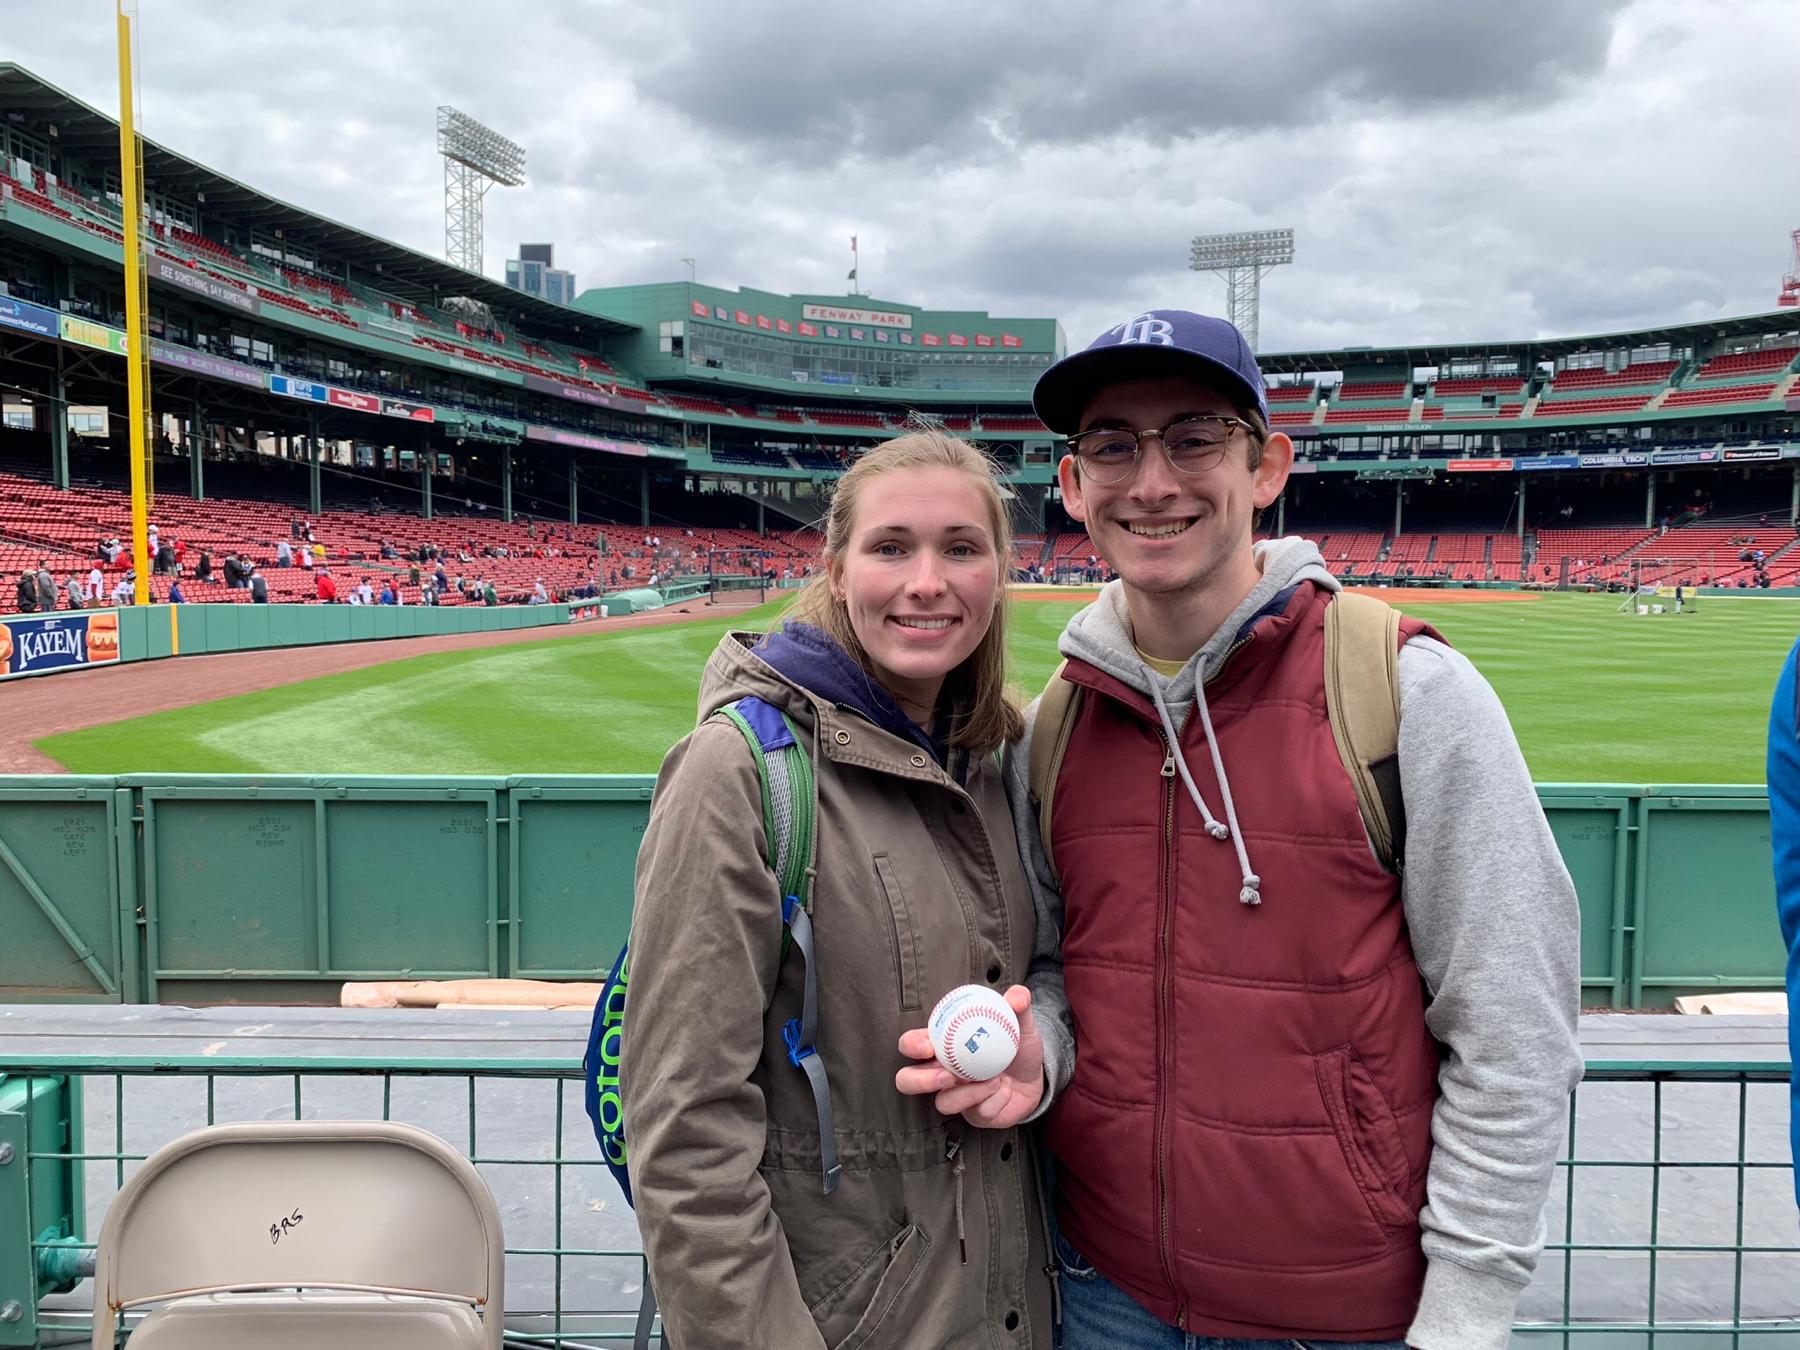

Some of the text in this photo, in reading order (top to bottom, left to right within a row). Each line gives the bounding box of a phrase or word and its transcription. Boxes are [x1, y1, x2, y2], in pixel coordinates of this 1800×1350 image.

[160, 264, 174, 280] SEE
[209, 283, 222, 298] SAY
[809, 307, 905, 326] FENWAY PARK
[1110, 312, 1175, 347] TB
[1583, 455, 1645, 465] COLUMBIA TECH
[18, 628, 84, 670] KAYEM
